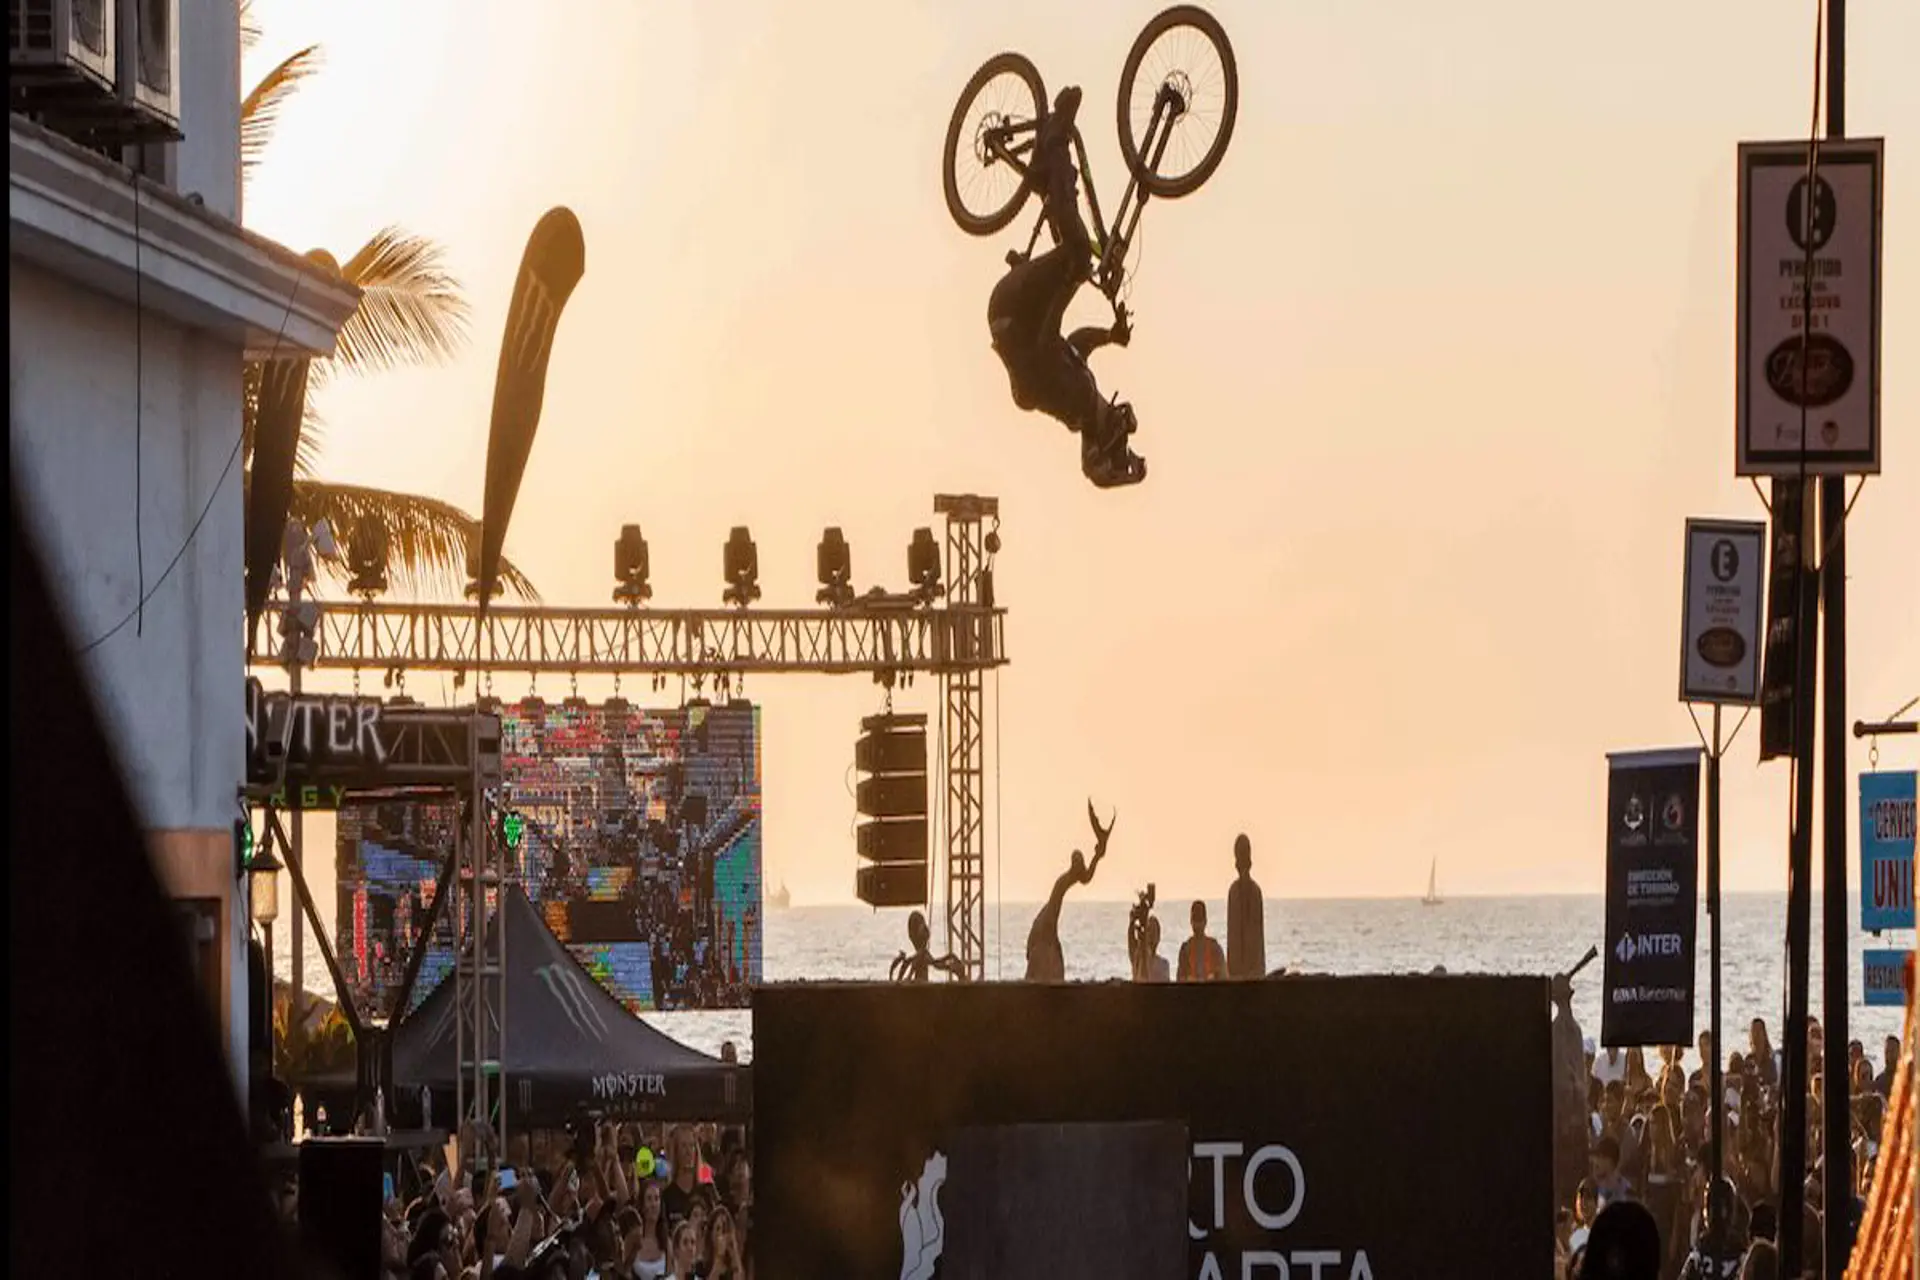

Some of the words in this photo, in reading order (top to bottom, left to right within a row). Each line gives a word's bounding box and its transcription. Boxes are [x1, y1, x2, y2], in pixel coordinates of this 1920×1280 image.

[1779, 259, 1842, 277] PERITIDO
[1780, 295, 1841, 309] EXCUSIVO
[1717, 544, 1731, 578] E
[1638, 933, 1682, 956] INTER
[591, 1071, 667, 1099] MONSTER
